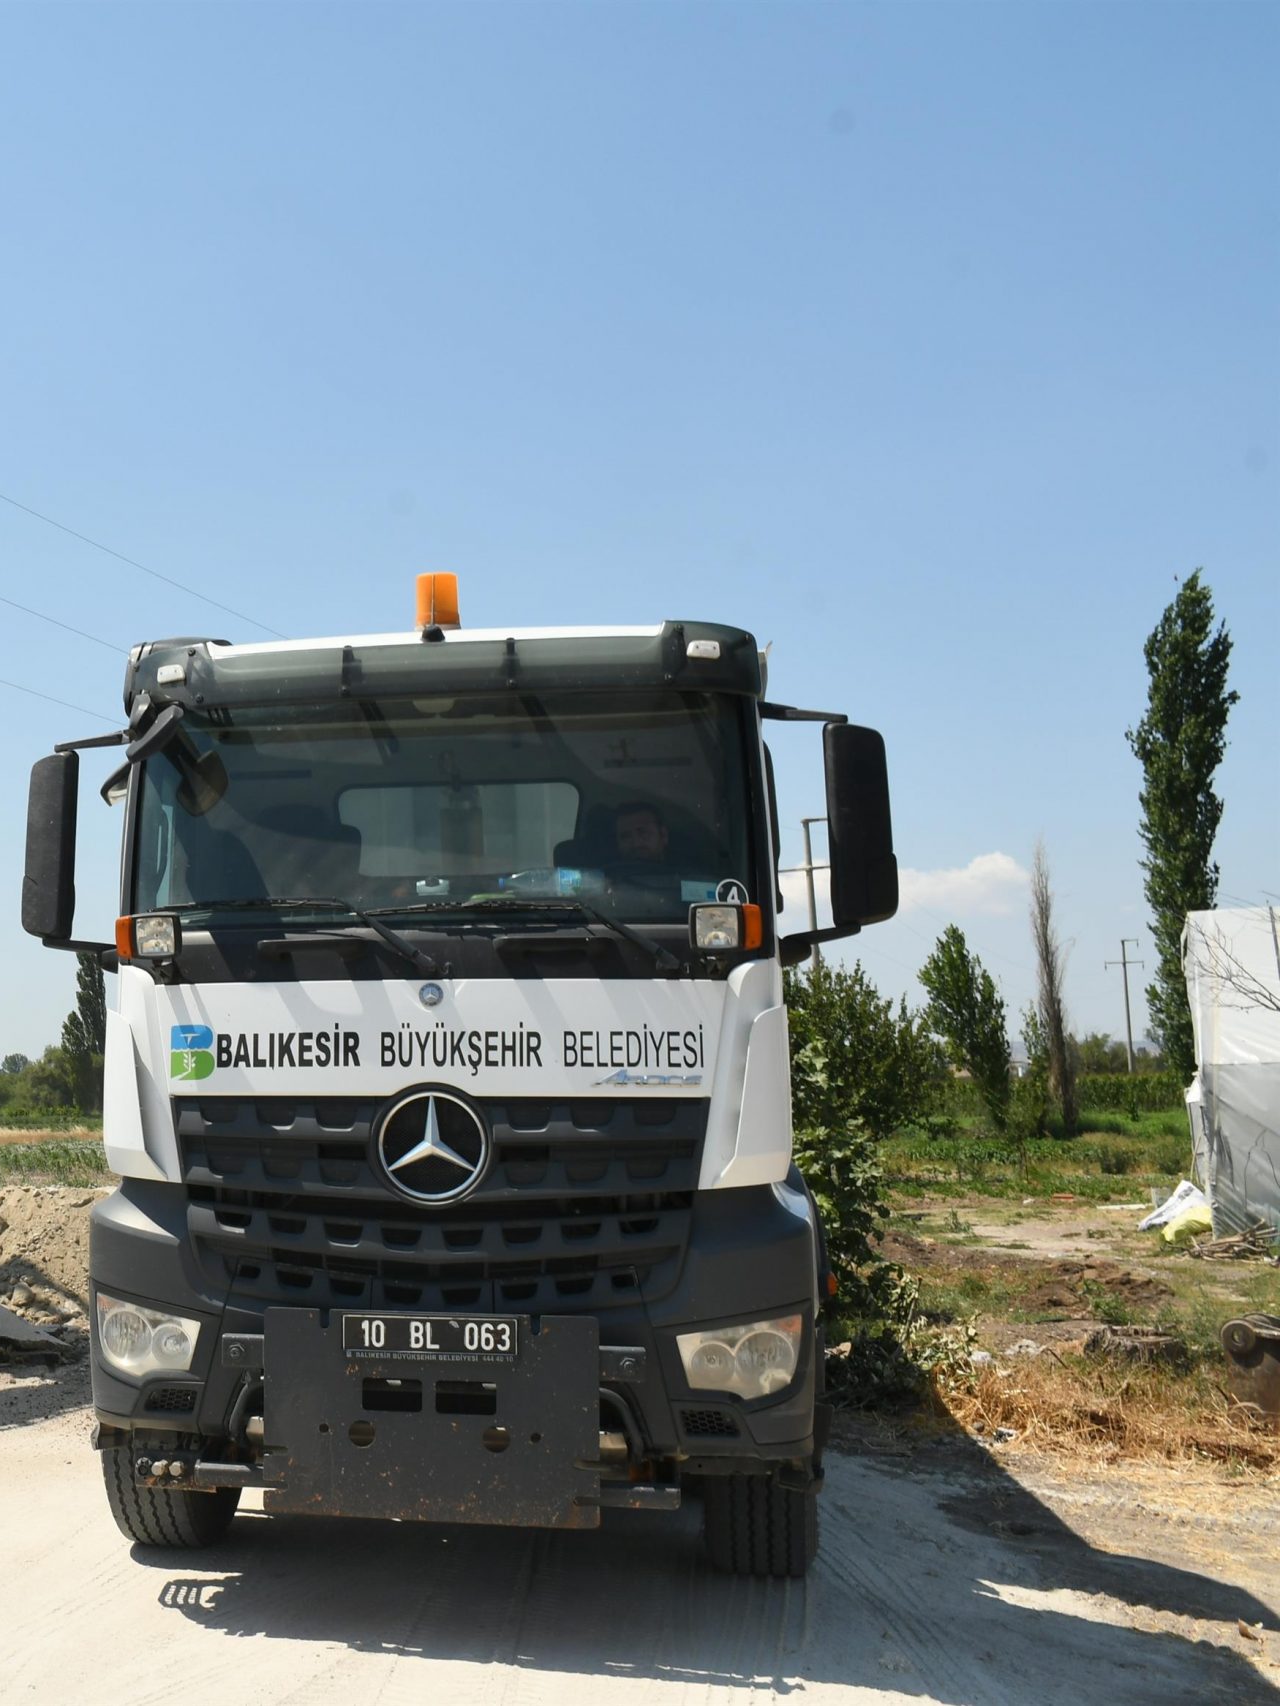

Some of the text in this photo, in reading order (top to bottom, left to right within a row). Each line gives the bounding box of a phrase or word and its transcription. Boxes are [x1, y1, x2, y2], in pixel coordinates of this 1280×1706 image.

[216, 1022, 361, 1069] BALIKESİR
[380, 1021, 543, 1076] BÜYÜKŞEHİR
[563, 1023, 705, 1069] BELEDİYESİ
[361, 1319, 511, 1351] 10 BL 063
